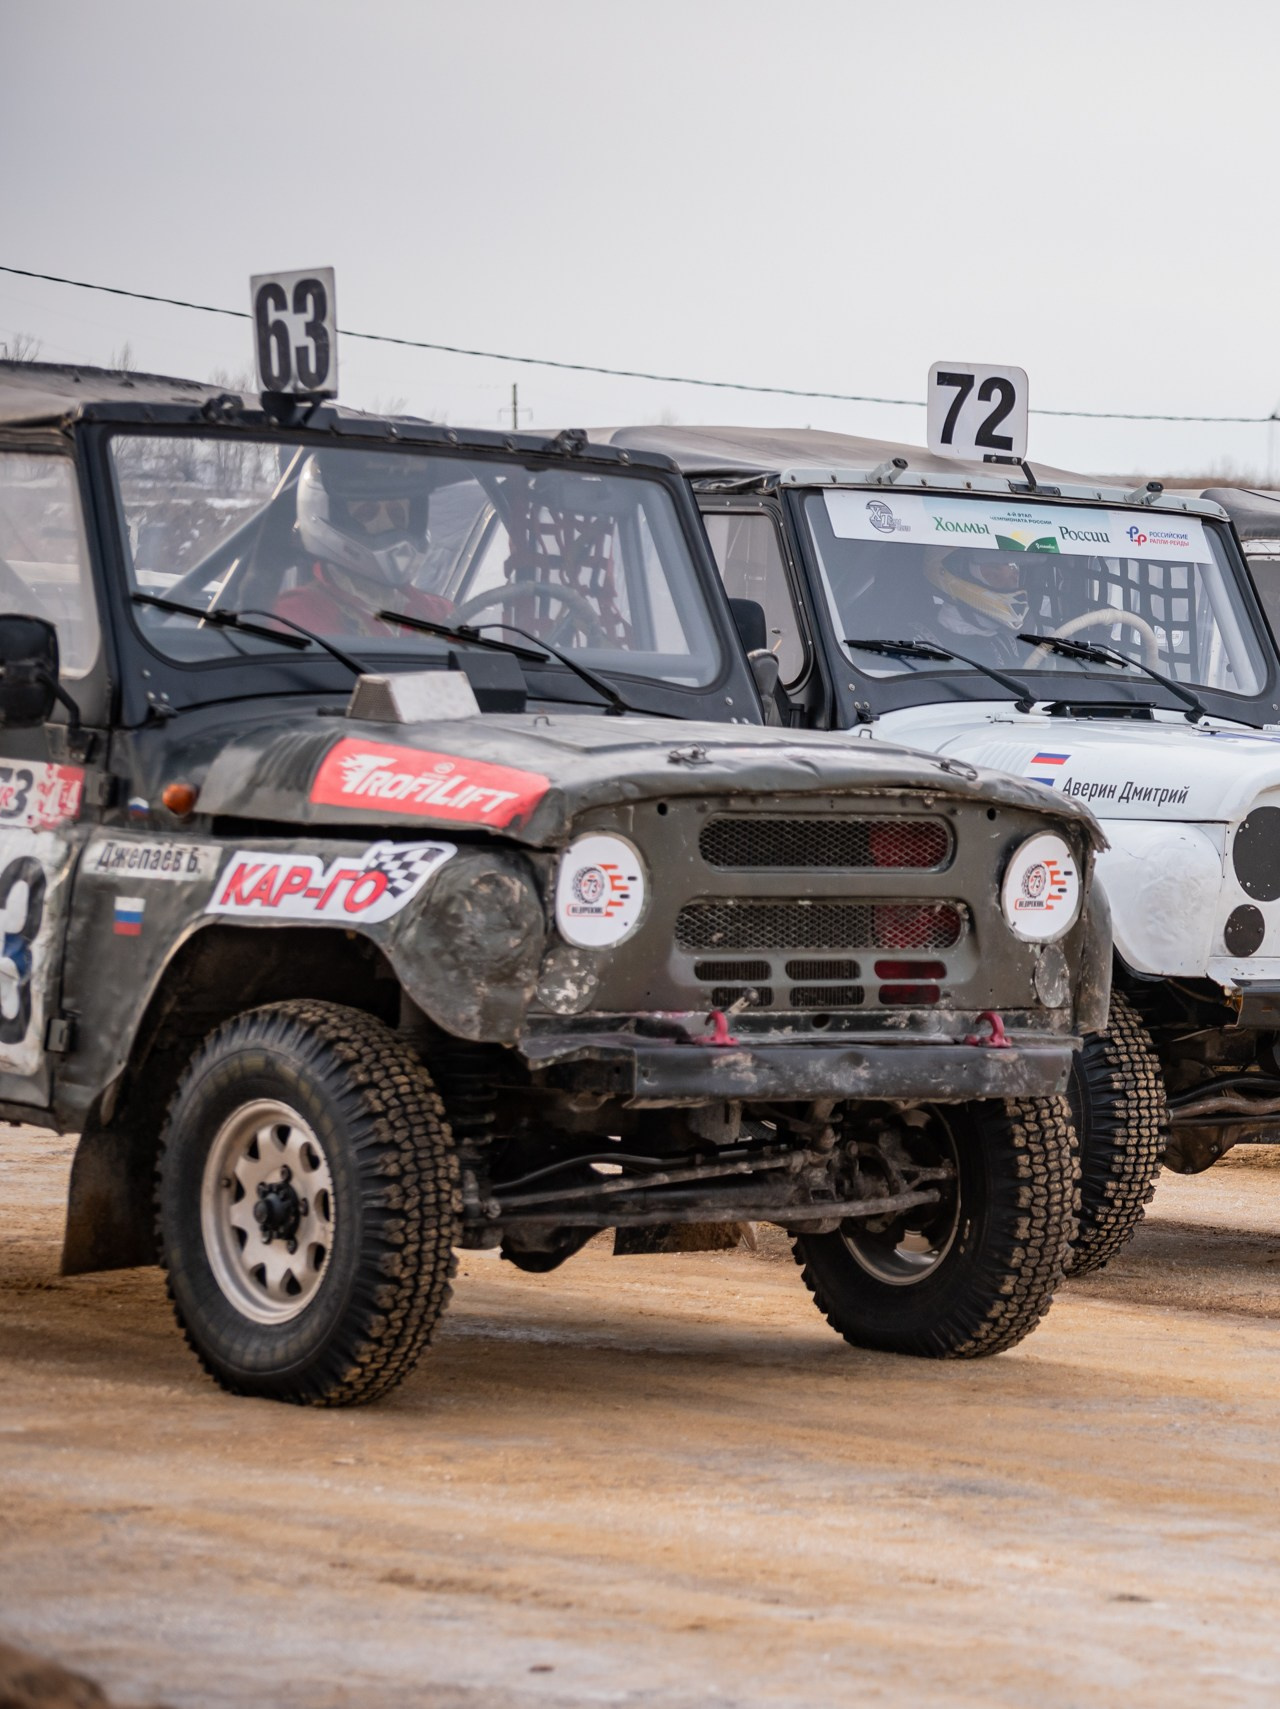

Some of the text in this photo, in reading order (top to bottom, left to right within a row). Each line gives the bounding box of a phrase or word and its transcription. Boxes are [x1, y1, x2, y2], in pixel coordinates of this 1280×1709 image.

[255, 278, 330, 391] 63
[936, 371, 1016, 451] 72
[932, 516, 990, 535] Холмы
[1058, 526, 1111, 543] России
[1149, 531, 1188, 540] РОССИЙСКИЕ
[1062, 777, 1191, 807] Аверин Дмитрий
[219, 862, 389, 914] КАР-ГО
